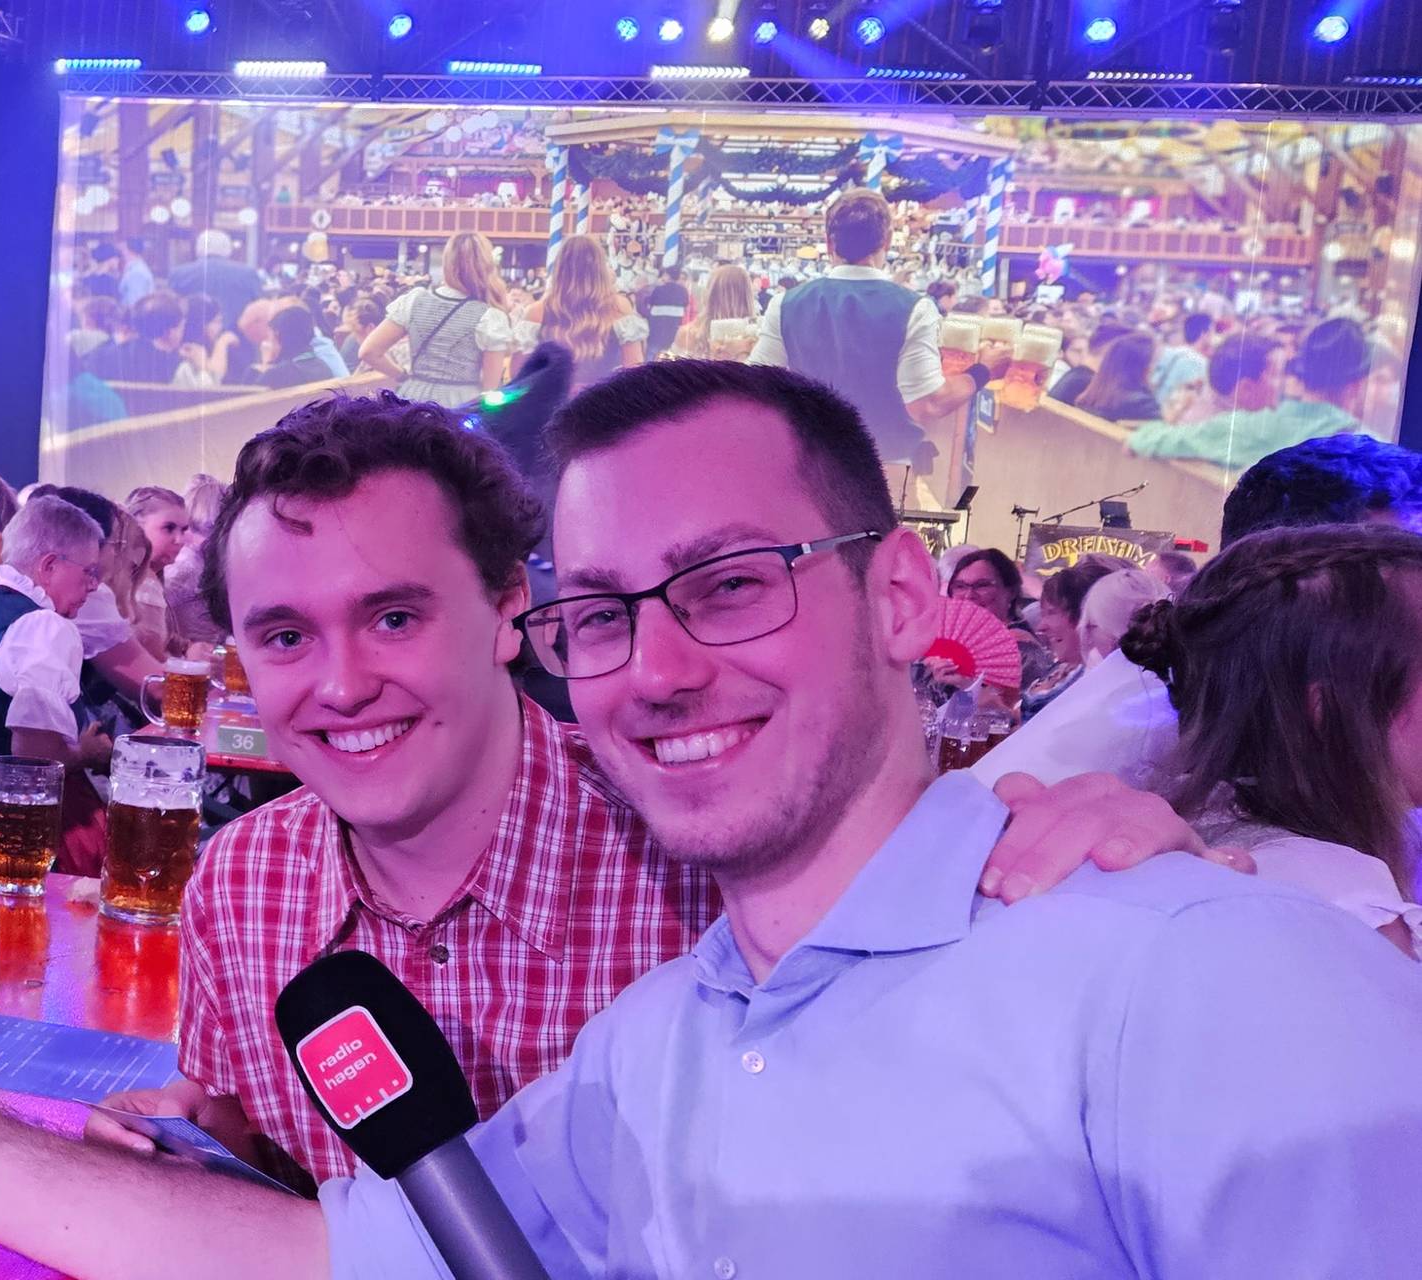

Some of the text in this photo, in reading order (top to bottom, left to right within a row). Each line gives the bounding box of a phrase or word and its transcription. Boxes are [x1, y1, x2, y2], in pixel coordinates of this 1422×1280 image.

[232, 733, 254, 751] 36
[318, 1038, 363, 1072] radio
[324, 1051, 378, 1090] hagen
